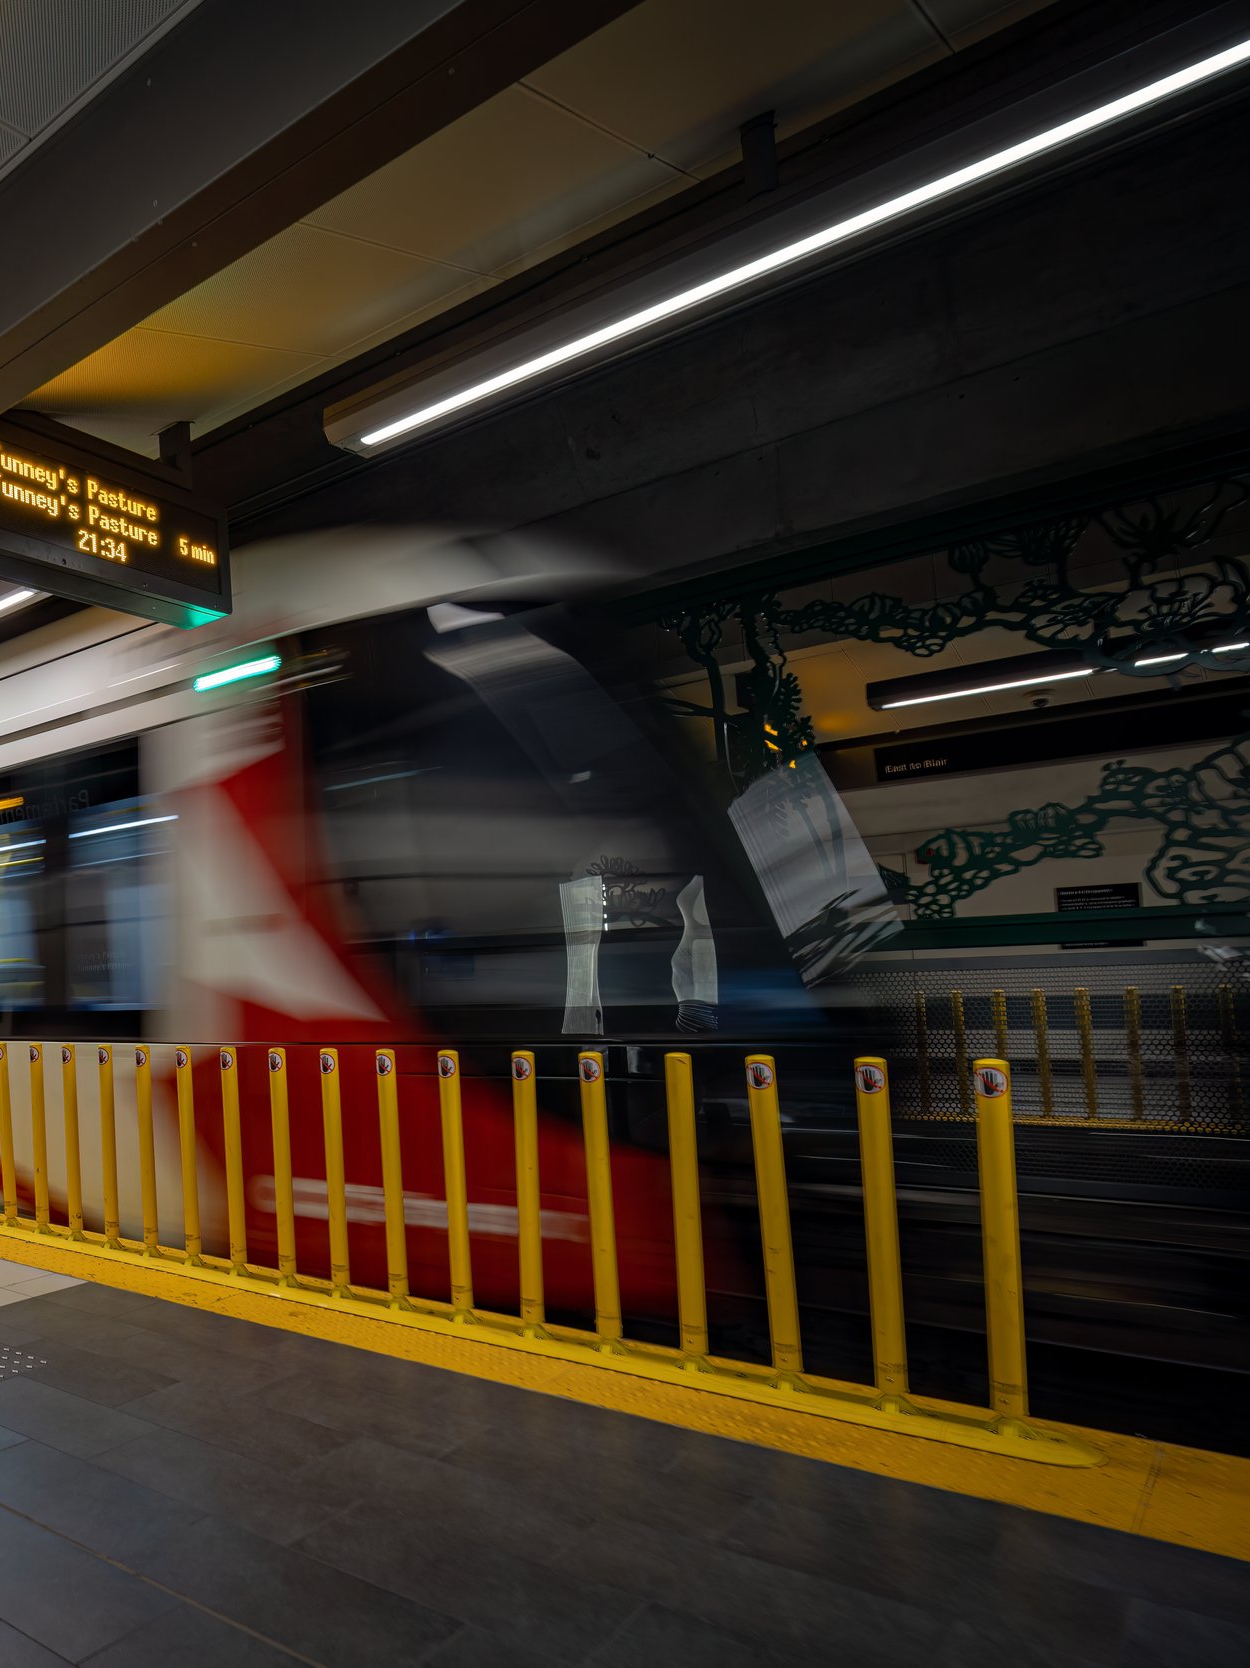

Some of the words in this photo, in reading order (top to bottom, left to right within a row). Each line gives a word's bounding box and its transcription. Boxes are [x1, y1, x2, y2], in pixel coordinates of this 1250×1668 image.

[87, 479, 157, 521] Pasture
[78, 530, 127, 562] 21:34
[89, 505, 158, 546] Pasture
[179, 538, 188, 556] 5
[191, 544, 215, 565] min
[884, 764, 907, 774] East
[923, 758, 948, 769] Blair
